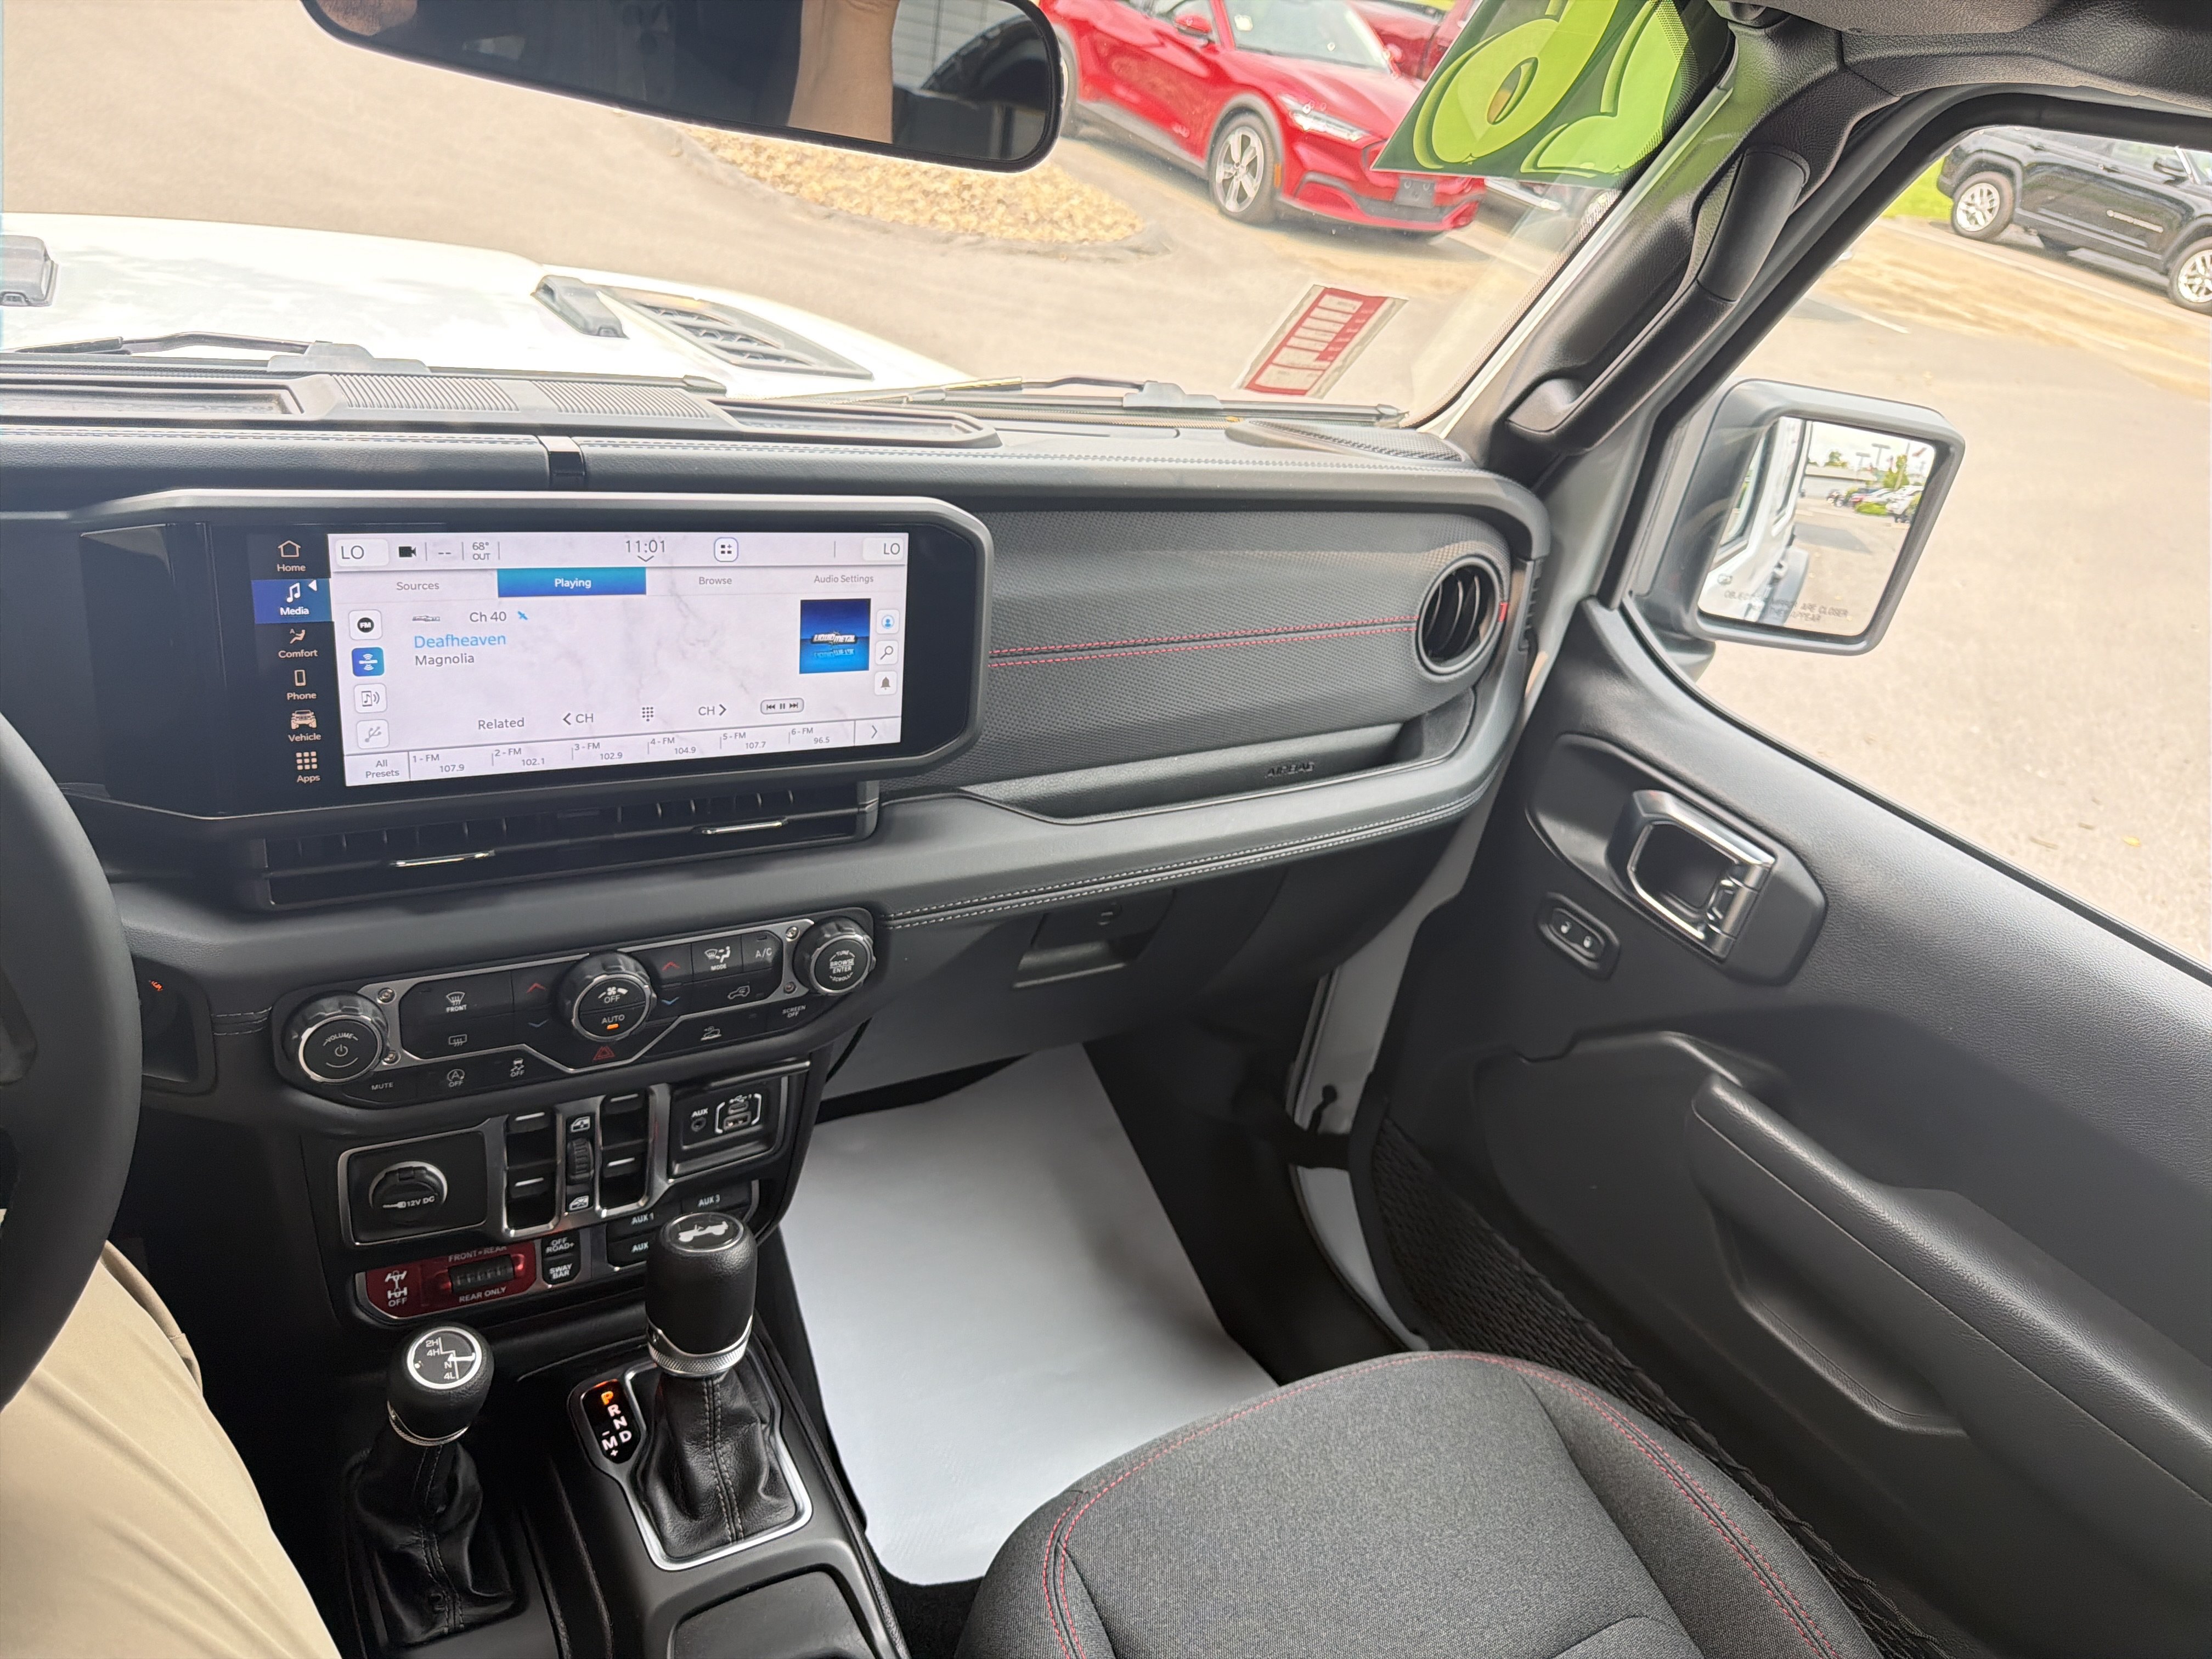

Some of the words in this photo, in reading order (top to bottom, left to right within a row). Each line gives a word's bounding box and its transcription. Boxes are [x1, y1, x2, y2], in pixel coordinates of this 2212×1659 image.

[625, 540, 666, 554] 11:01
[883, 542, 901, 555] LO
[341, 546, 364, 560] LO
[472, 552, 491, 561] OUT
[276, 563, 306, 572] Home
[554, 577, 592, 590] Playing
[698, 576, 732, 586] Browse
[813, 574, 839, 584] Audio
[840, 574, 874, 585] Settings
[396, 581, 439, 591] Sources
[280, 606, 309, 616] Media
[469, 611, 487, 623] Ch
[490, 611, 507, 622] 40
[414, 634, 506, 648] Deafheaven
[278, 649, 318, 658] Comfort
[415, 653, 475, 667] Magnolia
[286, 691, 317, 701] Phone
[698, 706, 715, 716] CH
[575, 713, 594, 724] CH
[477, 718, 525, 730] Related
[287, 732, 321, 742] Vehicle
[674, 746, 696, 754] 104.9
[600, 752, 623, 760] 102.9
[375, 759, 388, 768] All
[521, 758, 545, 766] 102.1
[439, 764, 465, 772] 107.9
[296, 774, 321, 784] Apps
[365, 769, 400, 779] Presets
[755, 947, 772, 958] A/C
[830, 958, 855, 967] BROWSE
[833, 966, 852, 974] ENTER
[604, 995, 620, 1003] OFF
[446, 1004, 467, 1013] FRONT
[783, 1005, 806, 1014] SCREEN
[601, 1014, 625, 1024] AUTO
[326, 1032, 354, 1042] VOLUME
[371, 1082, 394, 1091] MUTE
[691, 1108, 708, 1118] AUX
[407, 1199, 421, 1207] 12V
[423, 1195, 435, 1204] DC
[698, 1197, 714, 1207] AUX
[715, 1194, 720, 1203] 3
[631, 1215, 648, 1225] AUX
[551, 1237, 567, 1246] OFF
[631, 1242, 648, 1252] AUX
[549, 1263, 572, 1274] SWAY
[552, 1270, 569, 1279] BAR
[459, 1292, 482, 1302] REAR
[484, 1286, 507, 1297] ONLY
[388, 1297, 407, 1307] OFF
[425, 1339, 439, 1347] 2H
[426, 1348, 440, 1357] 4H
[444, 1361, 452, 1369] N
[443, 1372, 456, 1380] 4L
[601, 1391, 614, 1405] P
[607, 1404, 622, 1417] R
[613, 1415, 628, 1430] N
[619, 1430, 632, 1443] D
[601, 1435, 618, 1451] M
